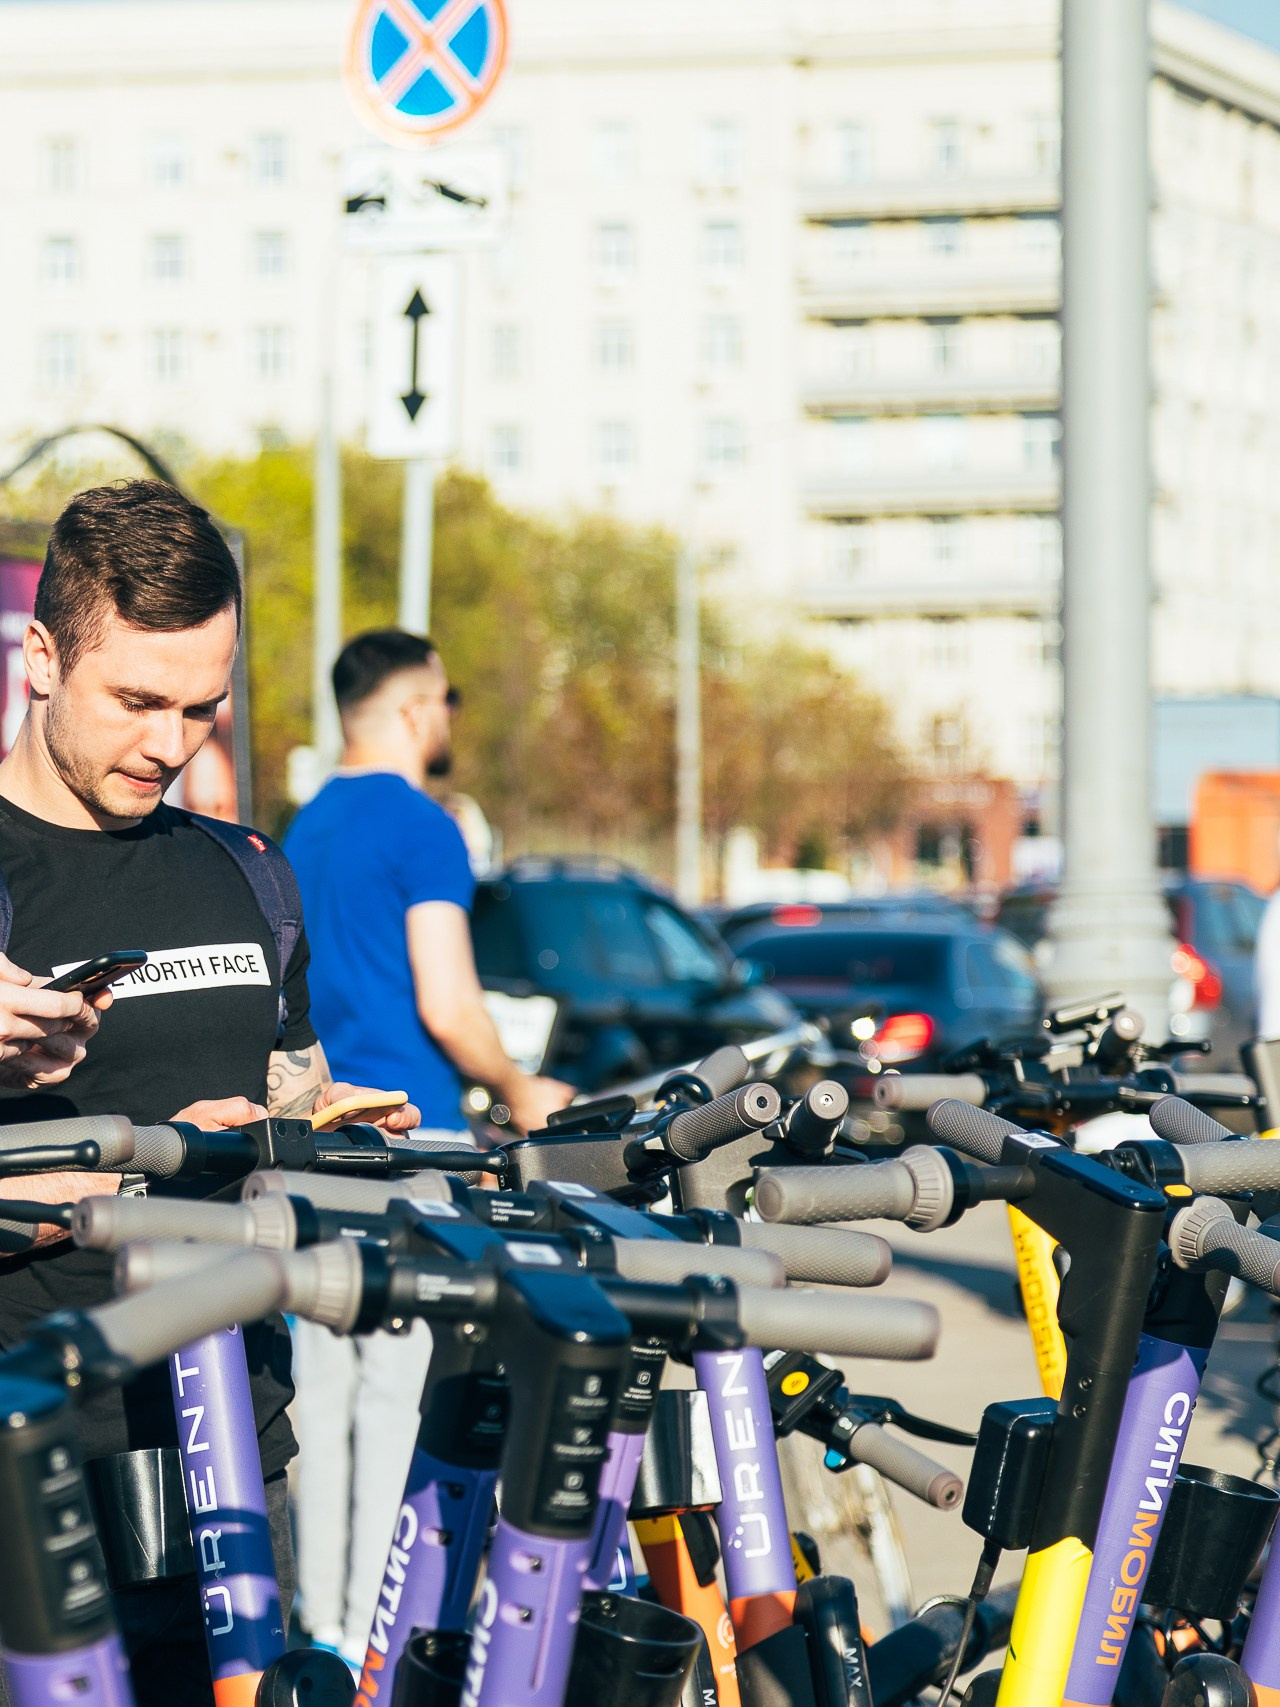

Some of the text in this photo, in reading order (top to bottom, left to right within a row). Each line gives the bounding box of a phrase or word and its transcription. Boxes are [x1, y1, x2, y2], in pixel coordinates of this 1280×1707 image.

[129, 957, 206, 986] NORTH
[208, 953, 260, 975] FACE
[1095, 1391, 1191, 1667] СИТИМОБИЛ
[843, 1647, 863, 1688] MAX
